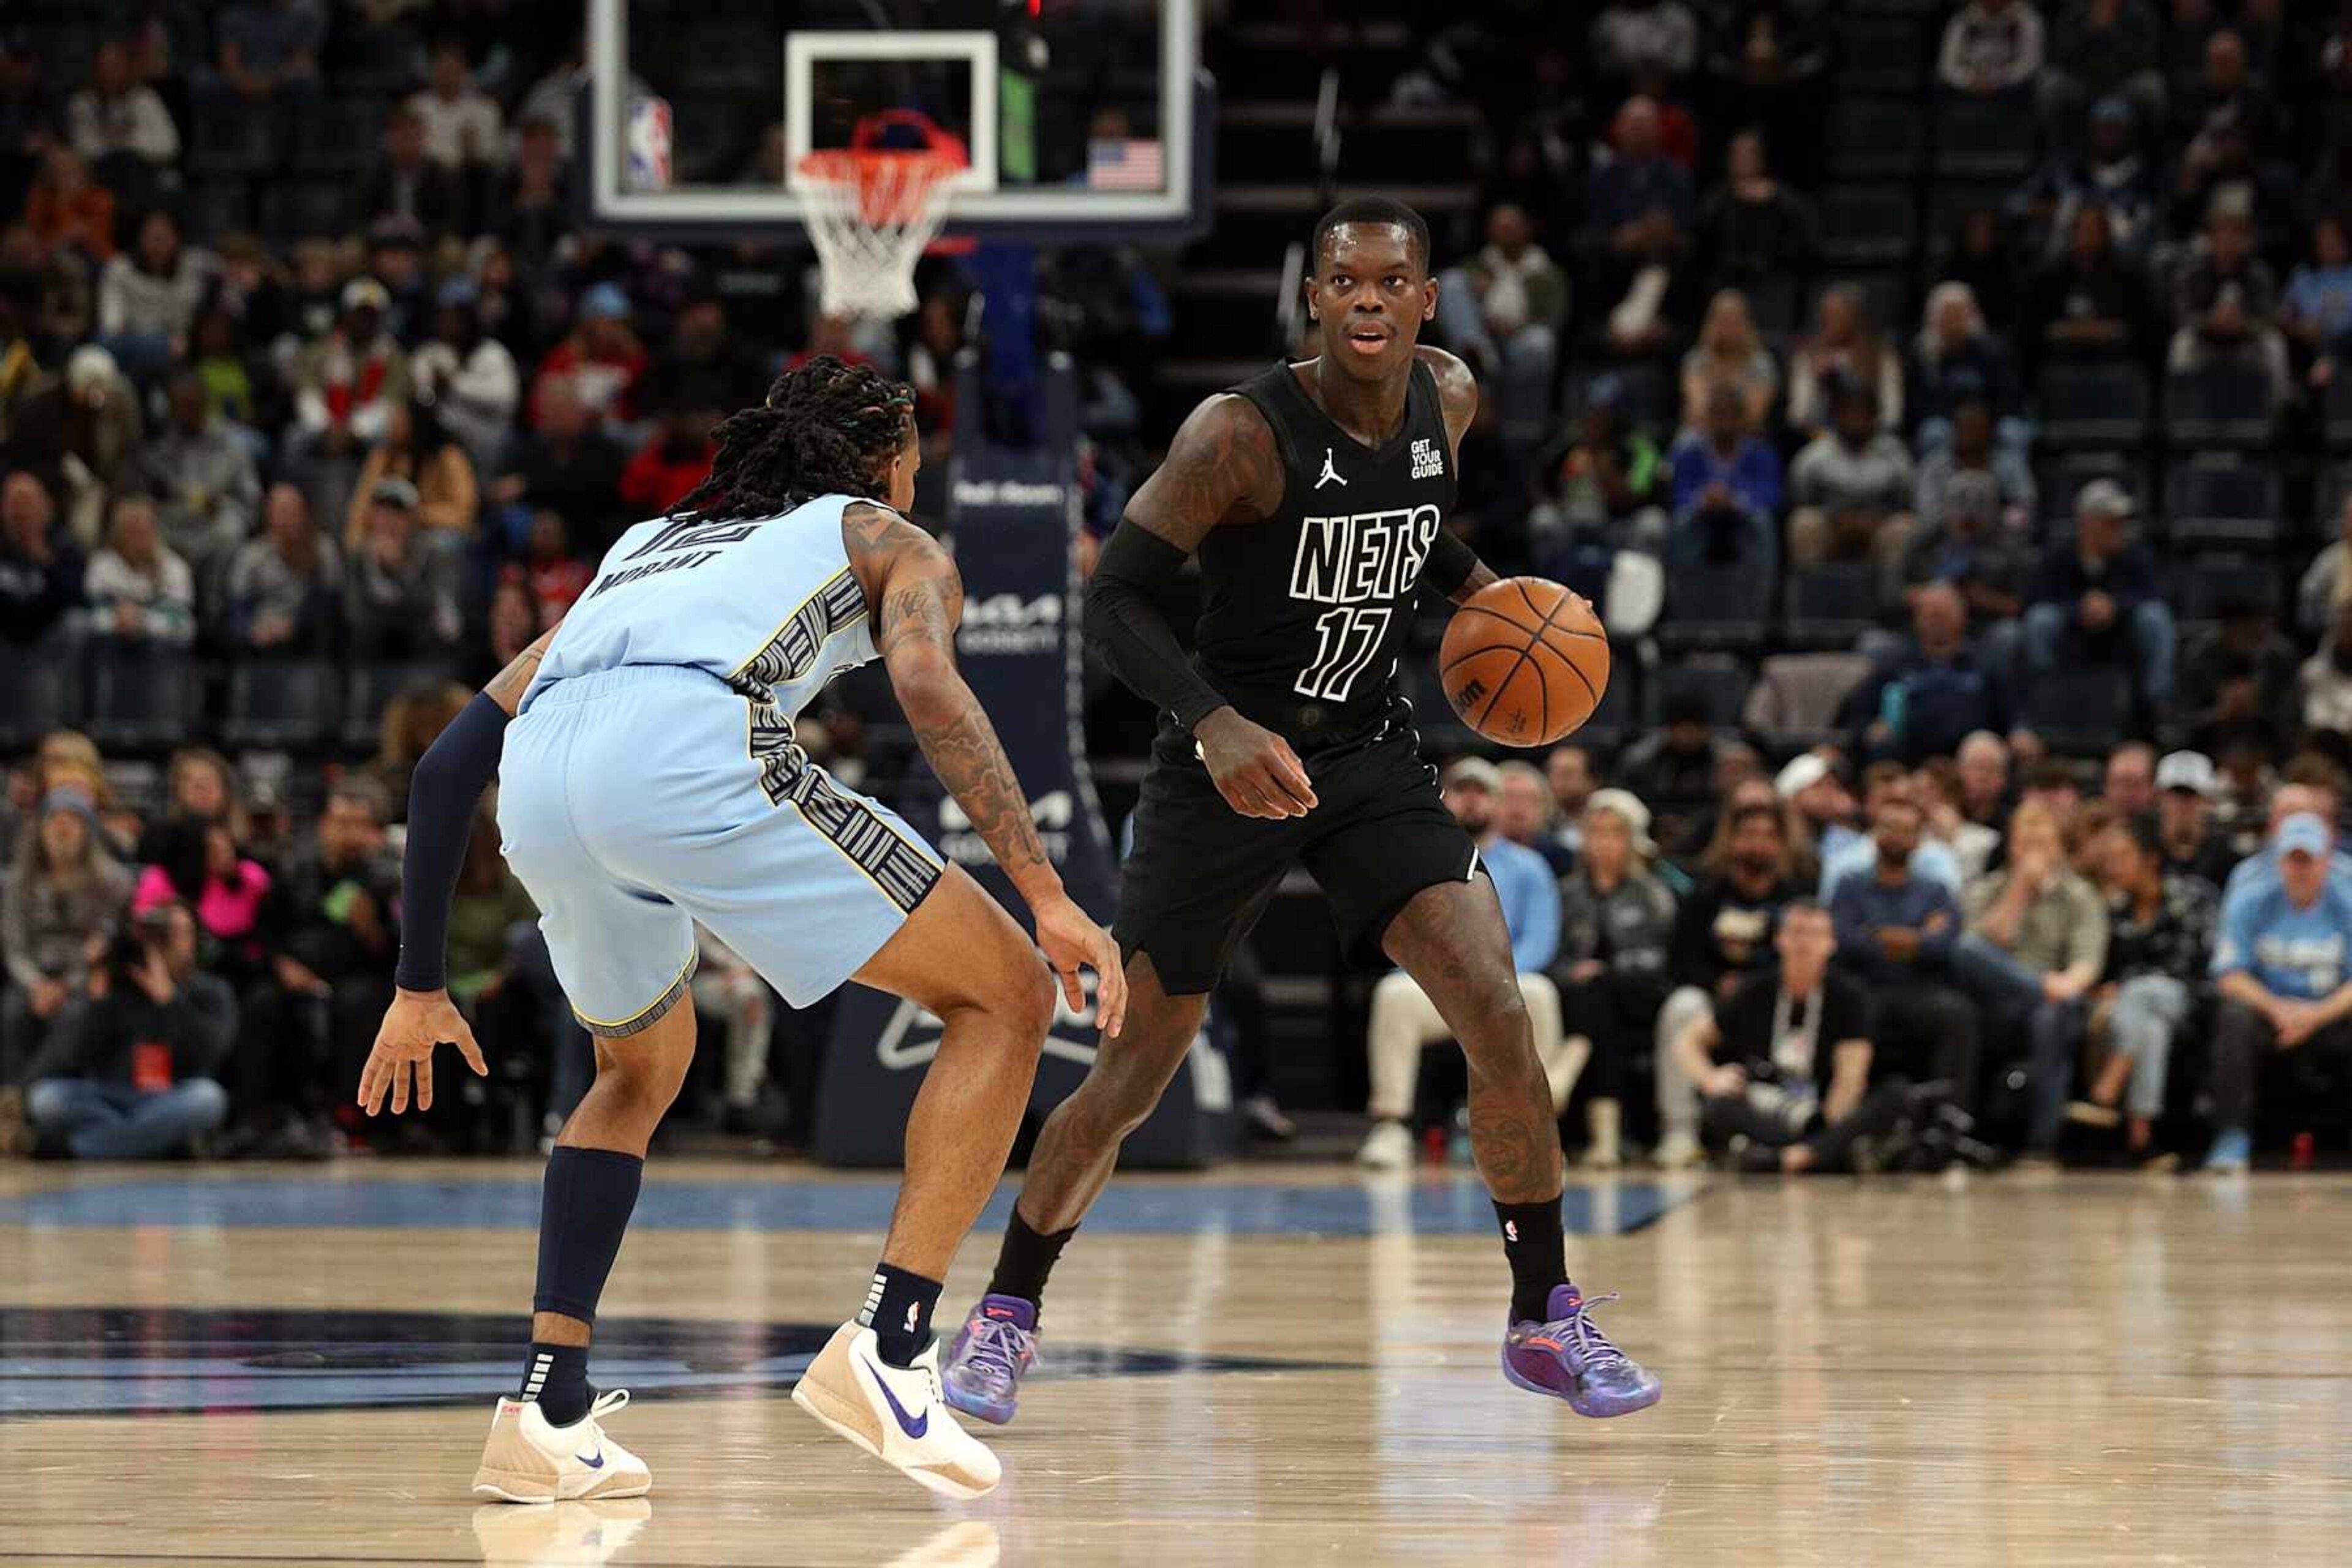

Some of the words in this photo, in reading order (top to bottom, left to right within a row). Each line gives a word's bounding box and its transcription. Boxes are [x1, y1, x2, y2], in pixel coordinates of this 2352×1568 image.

[1411, 439, 1430, 454] GET
[1412, 449, 1441, 466] YOUR
[1411, 462, 1444, 480] GUIDE
[1289, 503, 1441, 604] NETS
[589, 551, 724, 600] MORANT
[1294, 607, 1393, 703] 17
